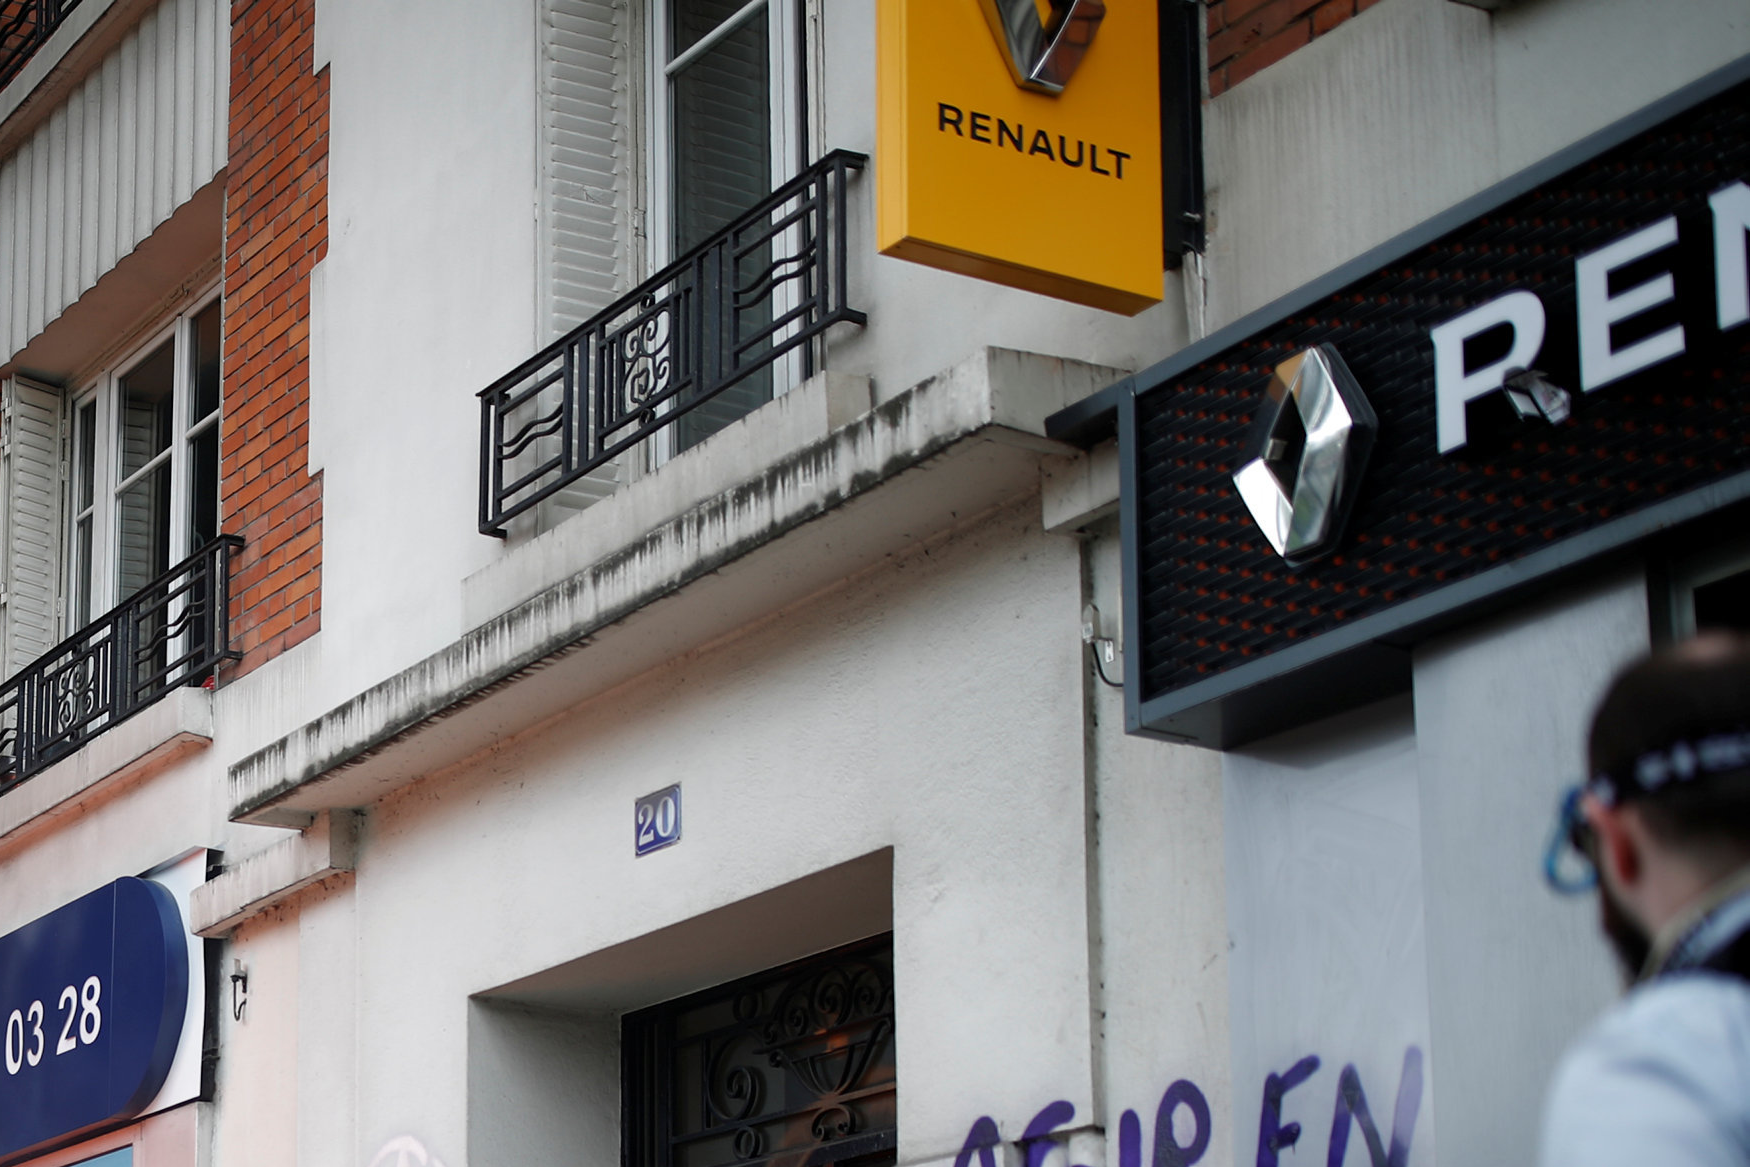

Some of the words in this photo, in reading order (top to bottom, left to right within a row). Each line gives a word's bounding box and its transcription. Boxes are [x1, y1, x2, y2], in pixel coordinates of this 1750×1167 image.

[937, 101, 1131, 180] RENAULT
[638, 796, 676, 847] 20
[5, 1000, 45, 1075] 03
[56, 975, 101, 1056] 28
